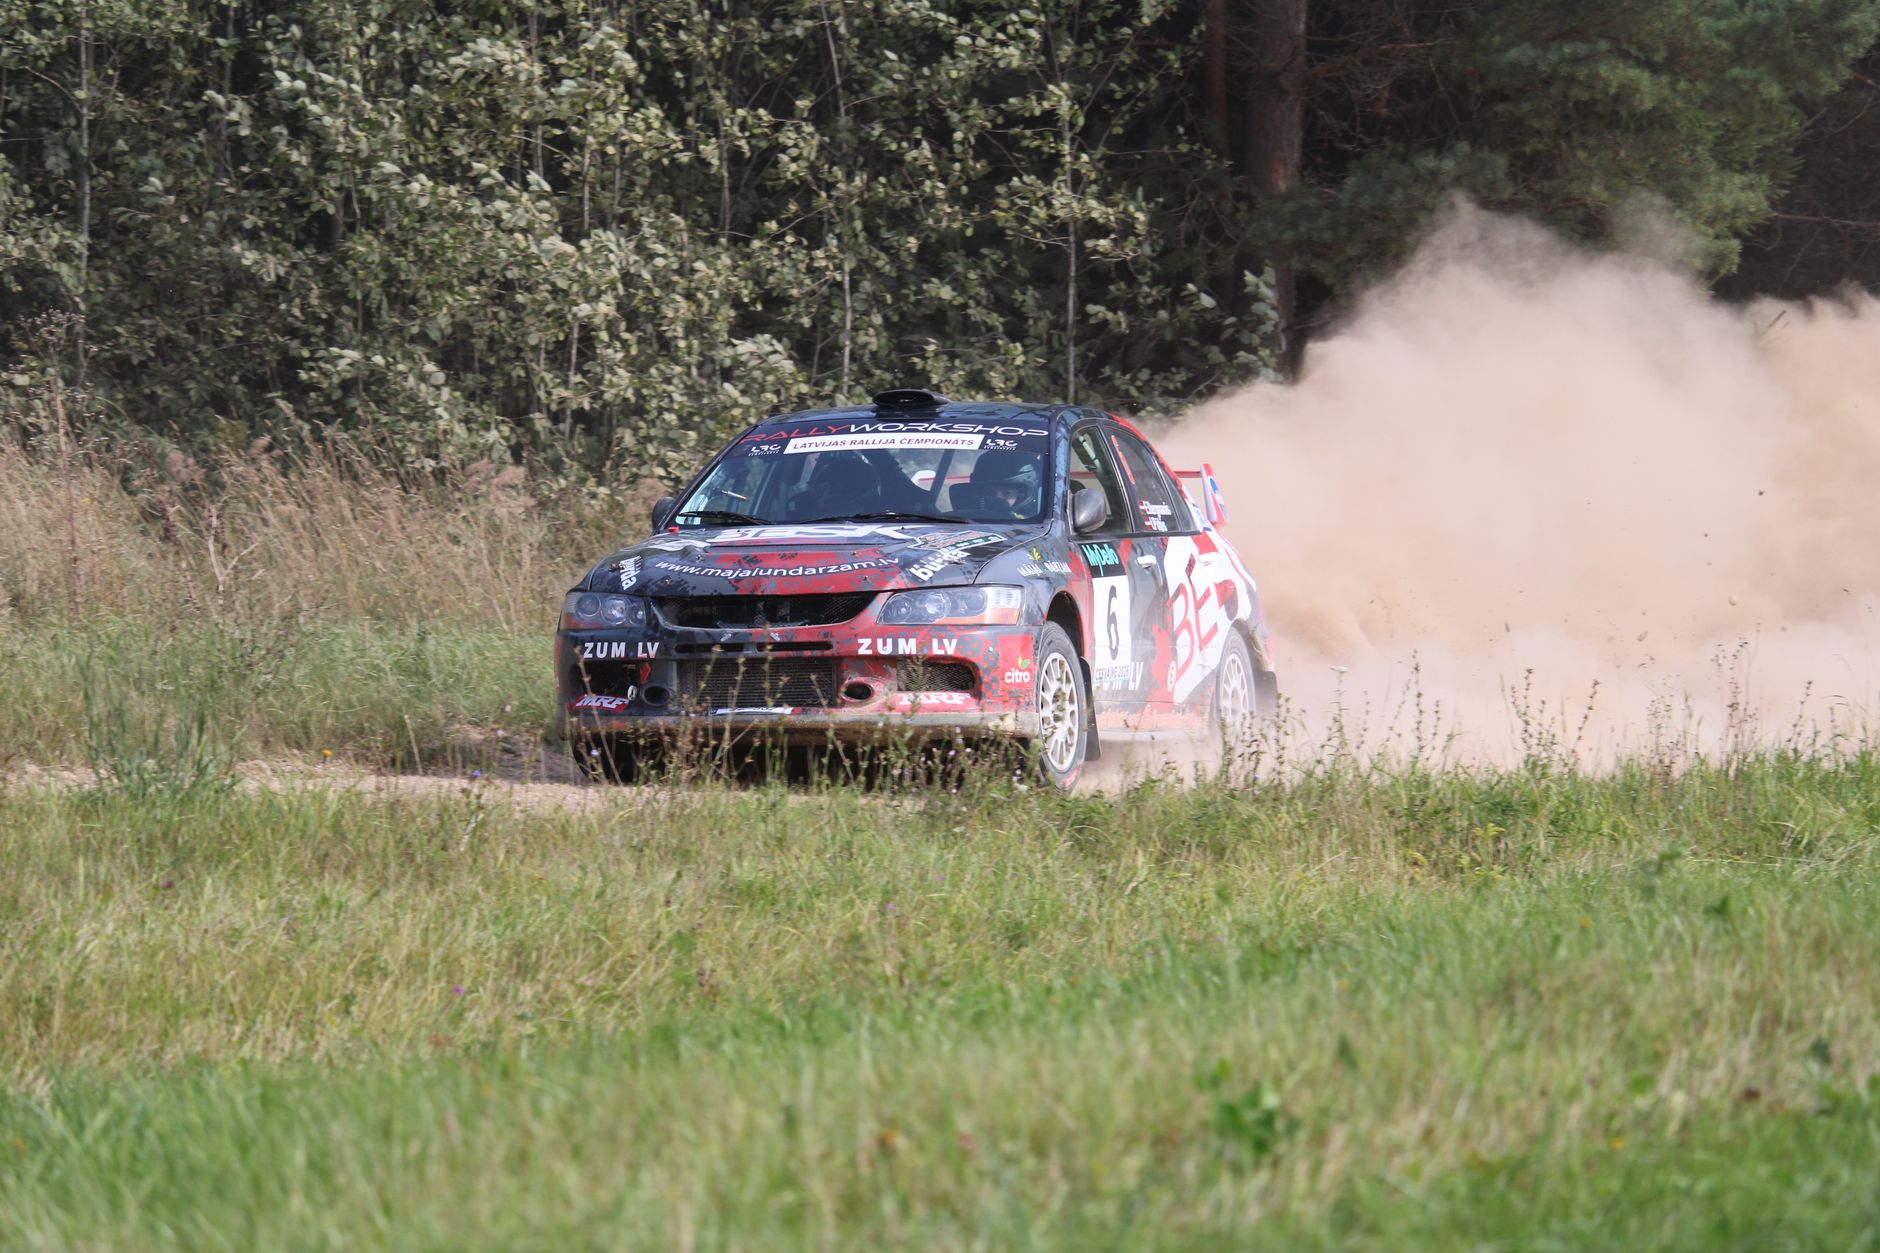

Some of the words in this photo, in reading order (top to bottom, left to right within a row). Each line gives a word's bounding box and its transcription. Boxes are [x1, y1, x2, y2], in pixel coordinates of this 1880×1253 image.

[793, 440, 846, 449] LATVIJAS
[849, 438, 896, 446] RALLIJA
[1107, 584, 1120, 661] 6
[1004, 668, 1030, 683] citro
